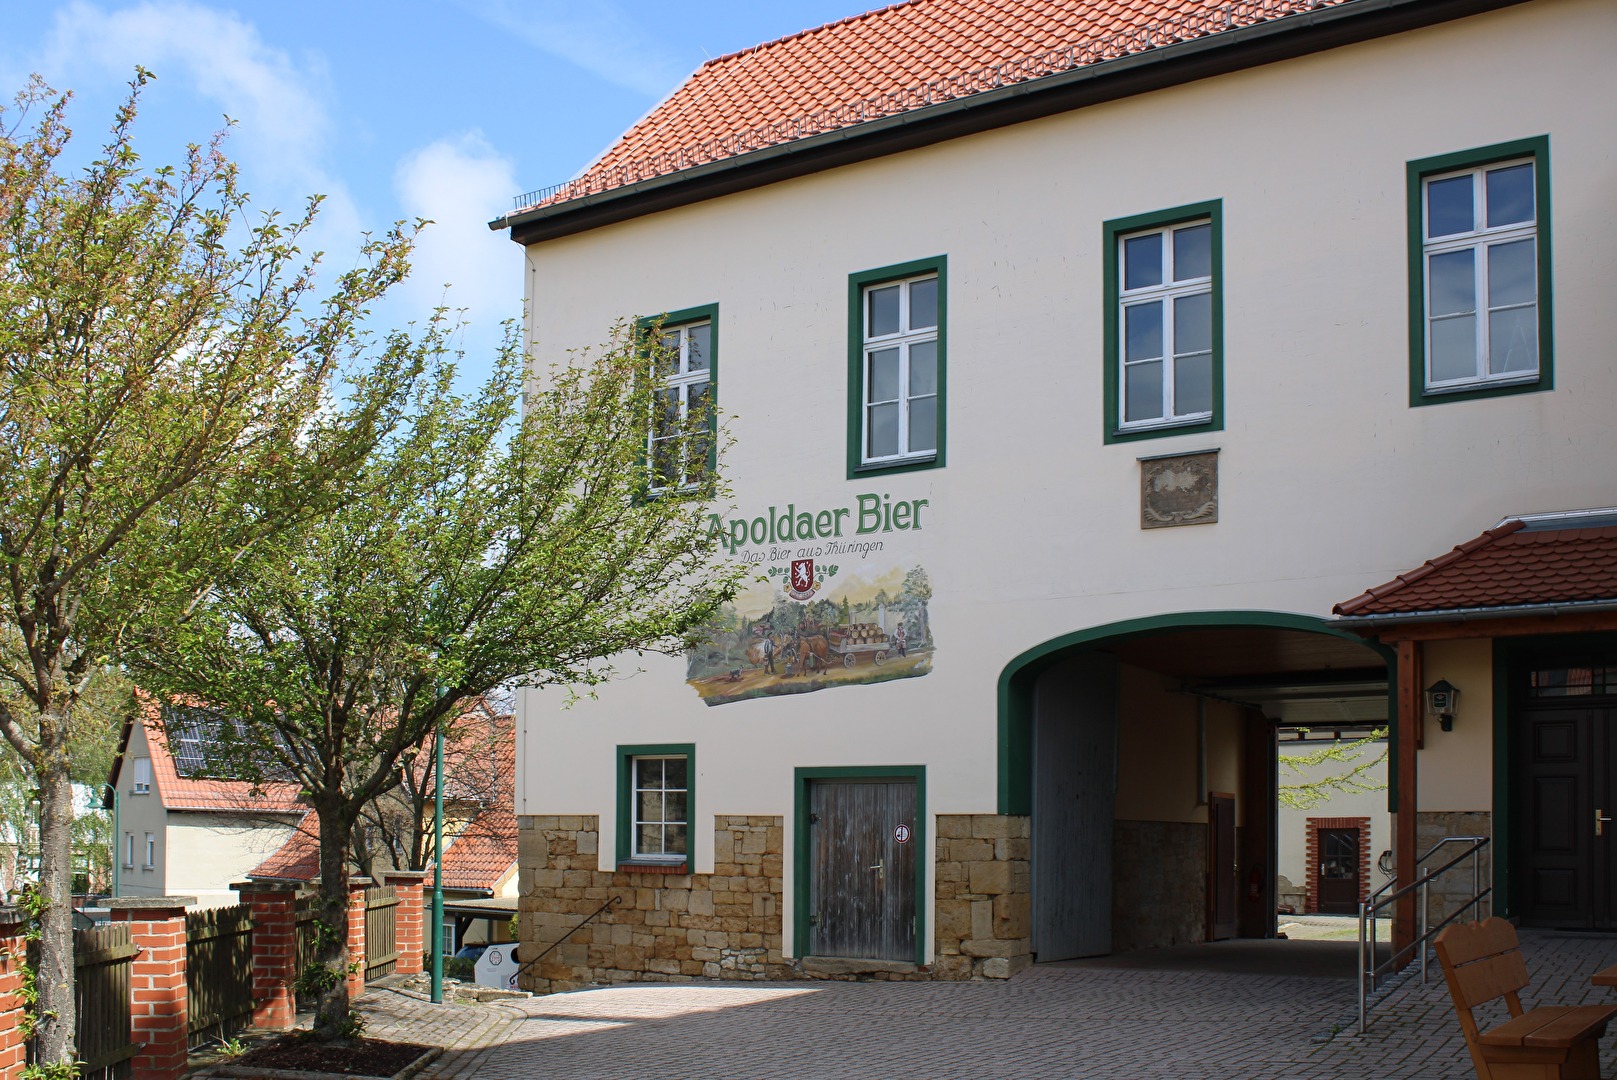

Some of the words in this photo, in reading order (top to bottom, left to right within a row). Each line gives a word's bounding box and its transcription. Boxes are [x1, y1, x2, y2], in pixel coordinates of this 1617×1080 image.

[705, 504, 850, 555] Apoldaer
[856, 493, 929, 535] Bier
[740, 549, 766, 564] Das
[767, 547, 791, 562] Bier
[797, 547, 823, 558] aus
[825, 541, 884, 558] Thüringen
